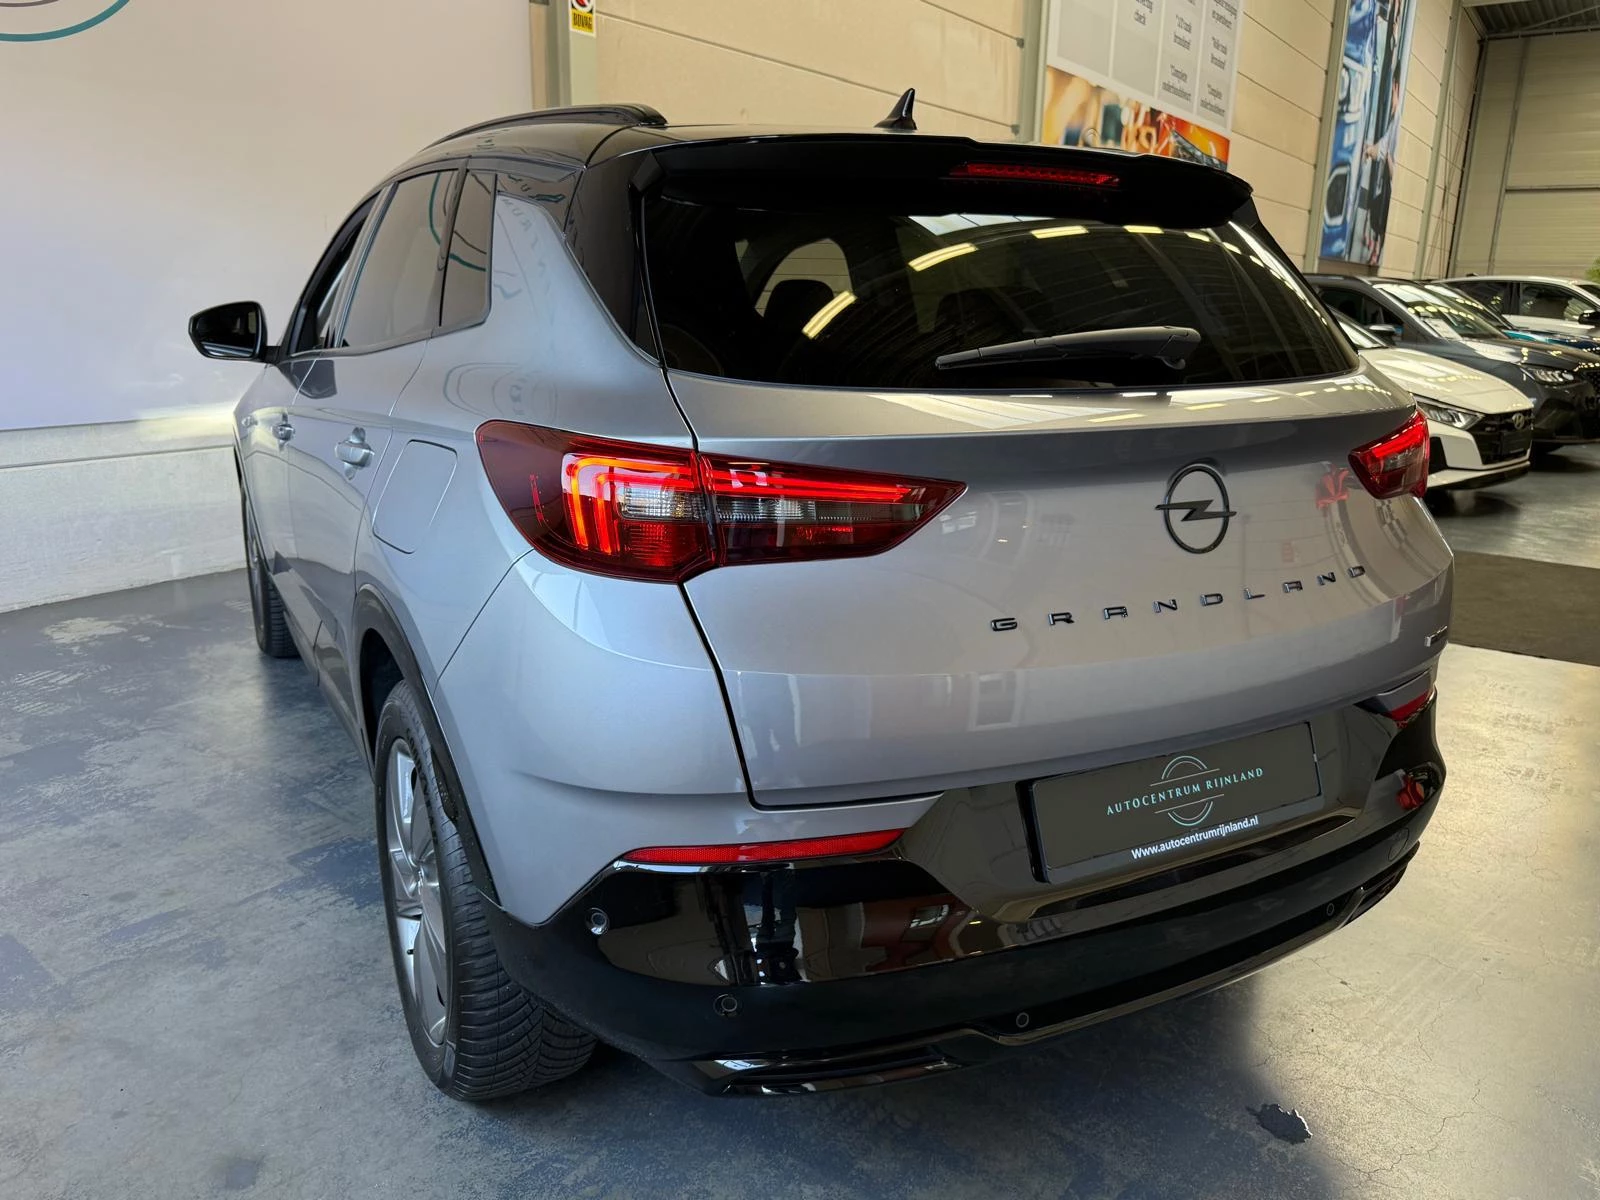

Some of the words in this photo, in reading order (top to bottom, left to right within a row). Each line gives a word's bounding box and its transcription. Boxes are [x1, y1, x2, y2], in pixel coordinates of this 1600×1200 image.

[990, 565, 1366, 632] GRANDLAND
[1106, 783, 1201, 816] AUTOCENTRUM
[1206, 767, 1264, 790] RIJNLAND
[1131, 815, 1259, 860] Www.autocentrumrijnland.nl
